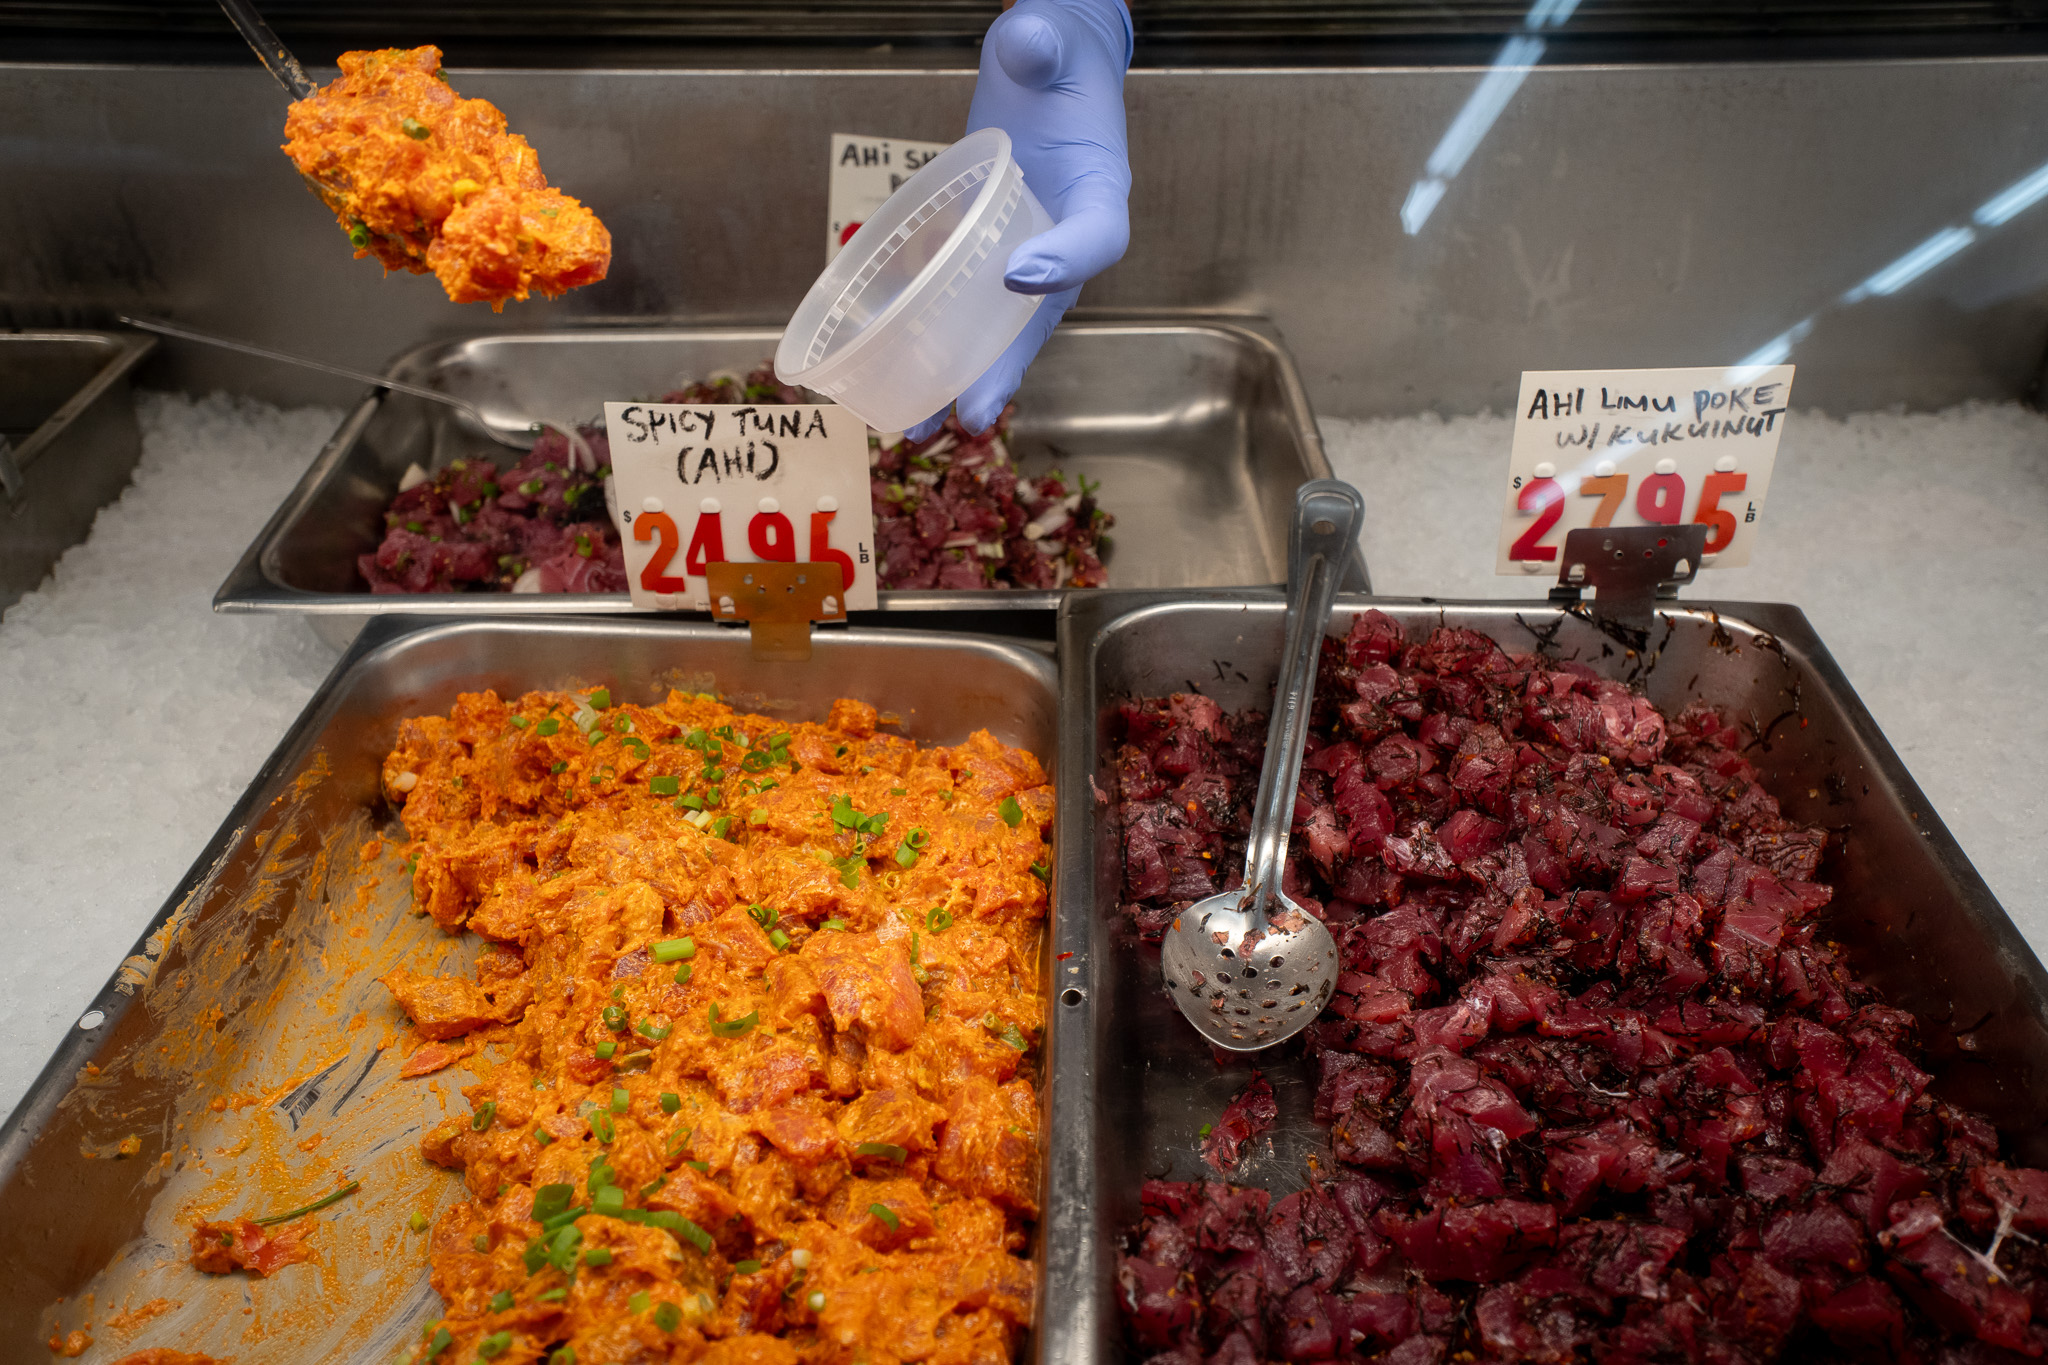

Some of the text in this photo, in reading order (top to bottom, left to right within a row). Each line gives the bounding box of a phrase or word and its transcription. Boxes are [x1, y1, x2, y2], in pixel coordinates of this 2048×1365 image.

[1528, 387, 1585, 420] AHI
[1693, 383, 1783, 424] POKE
[621, 406, 828, 444] SPICY TUNA
[1607, 407, 1786, 447] KUKUINUT
